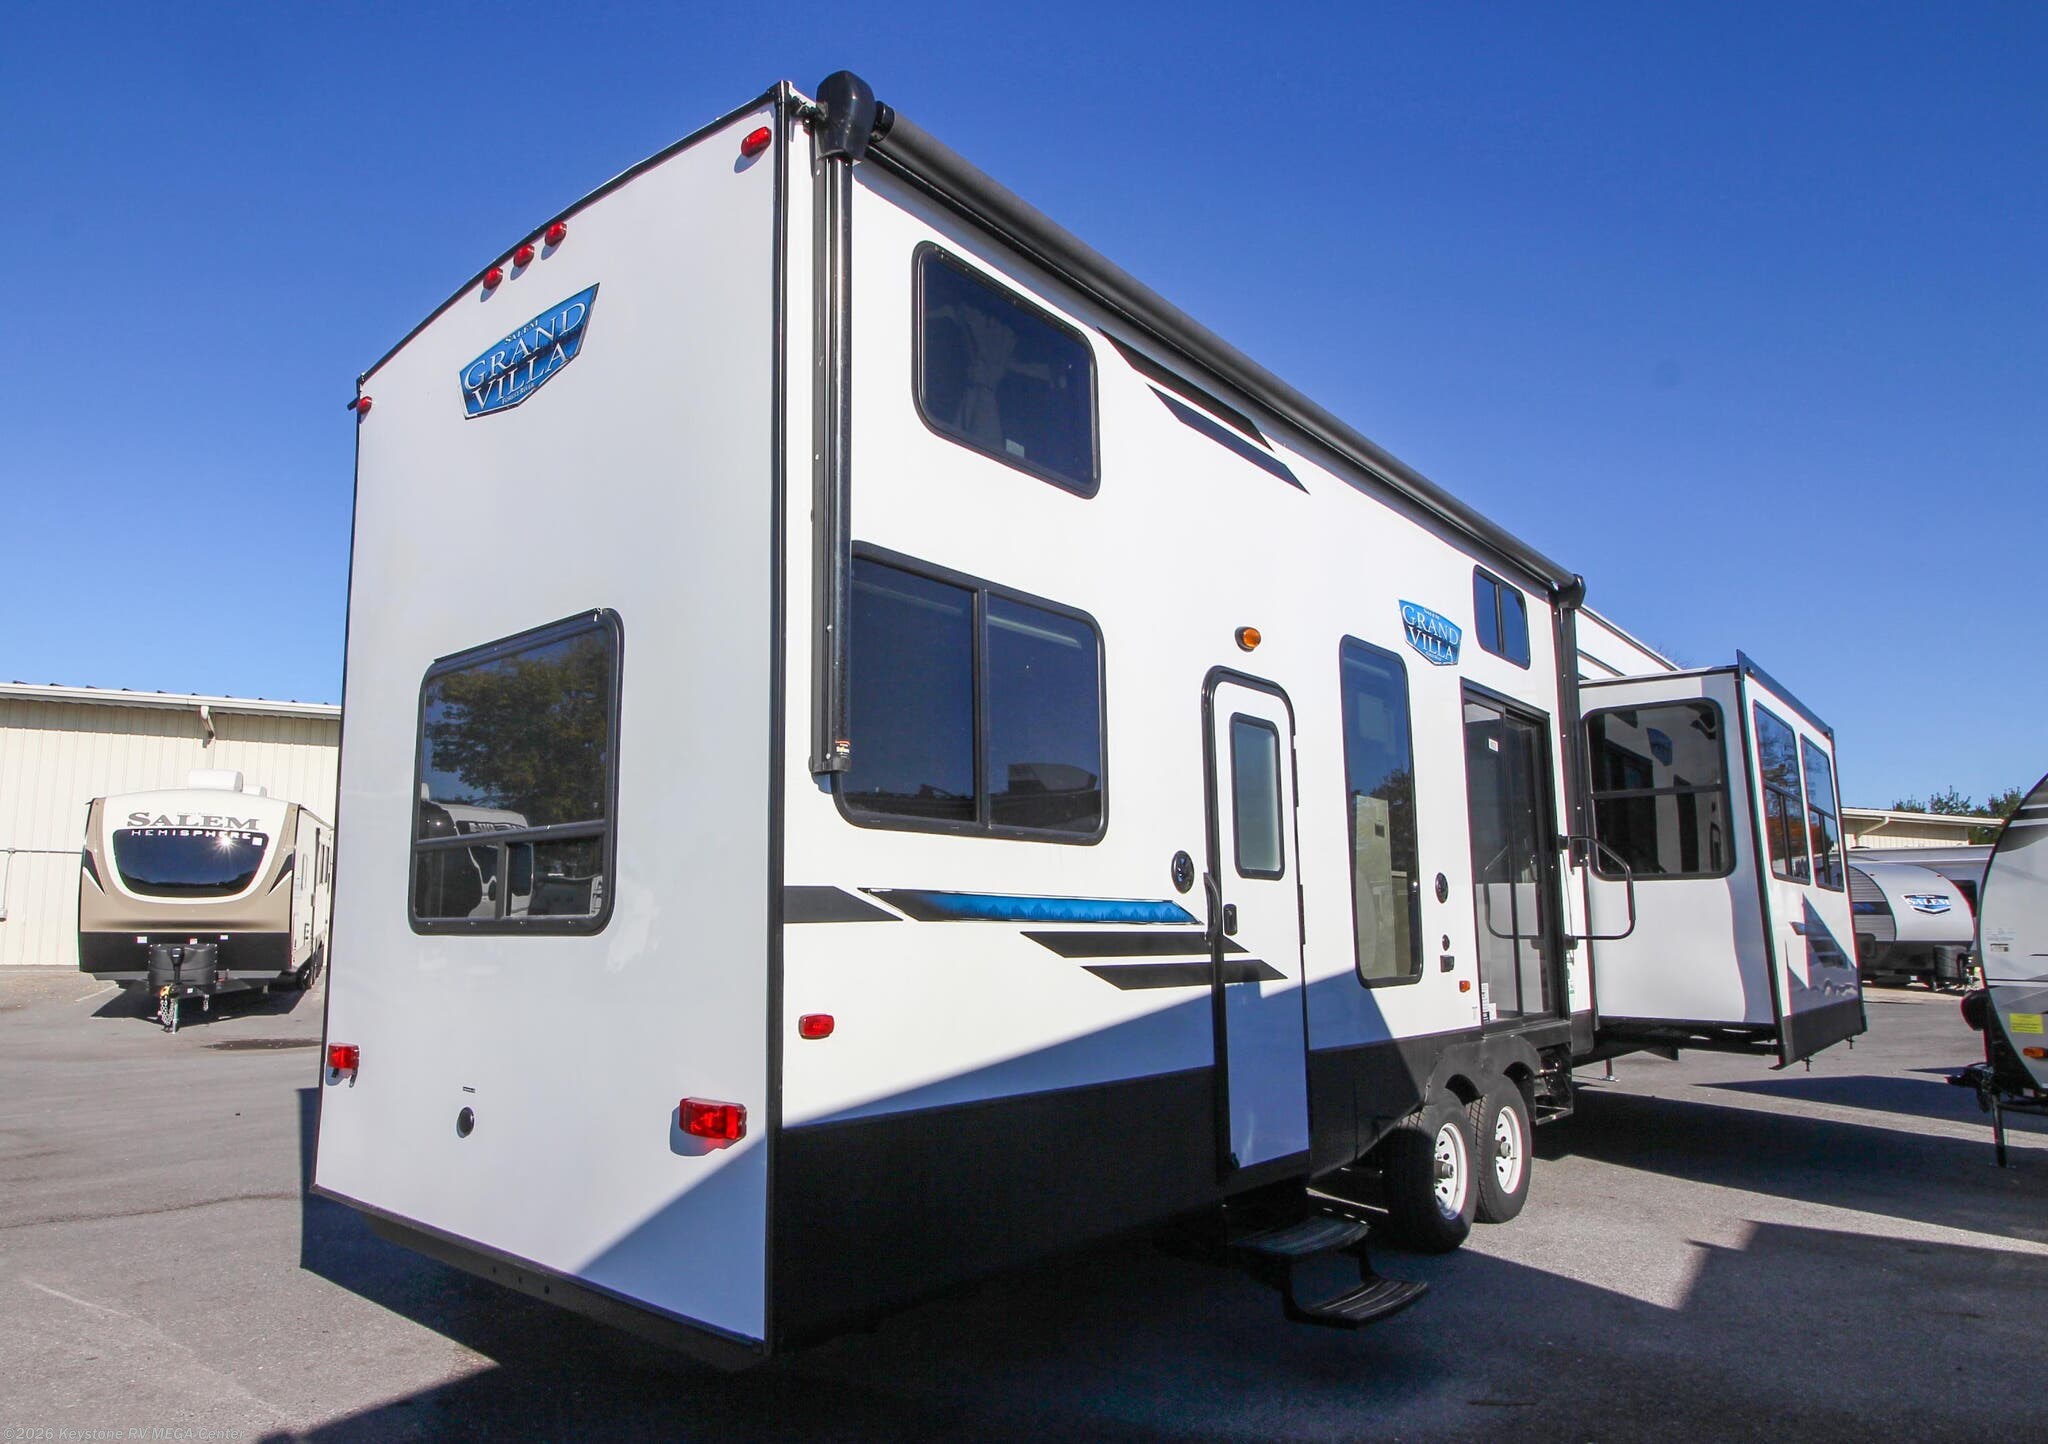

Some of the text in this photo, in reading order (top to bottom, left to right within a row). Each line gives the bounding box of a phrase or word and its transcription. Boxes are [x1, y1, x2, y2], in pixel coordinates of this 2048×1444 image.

[464, 302, 587, 390] GRAND
[472, 342, 571, 410] VILLA
[1402, 605, 1459, 645] GRAND
[1407, 625, 1454, 663] VILLA
[126, 811, 261, 831] SALEM
